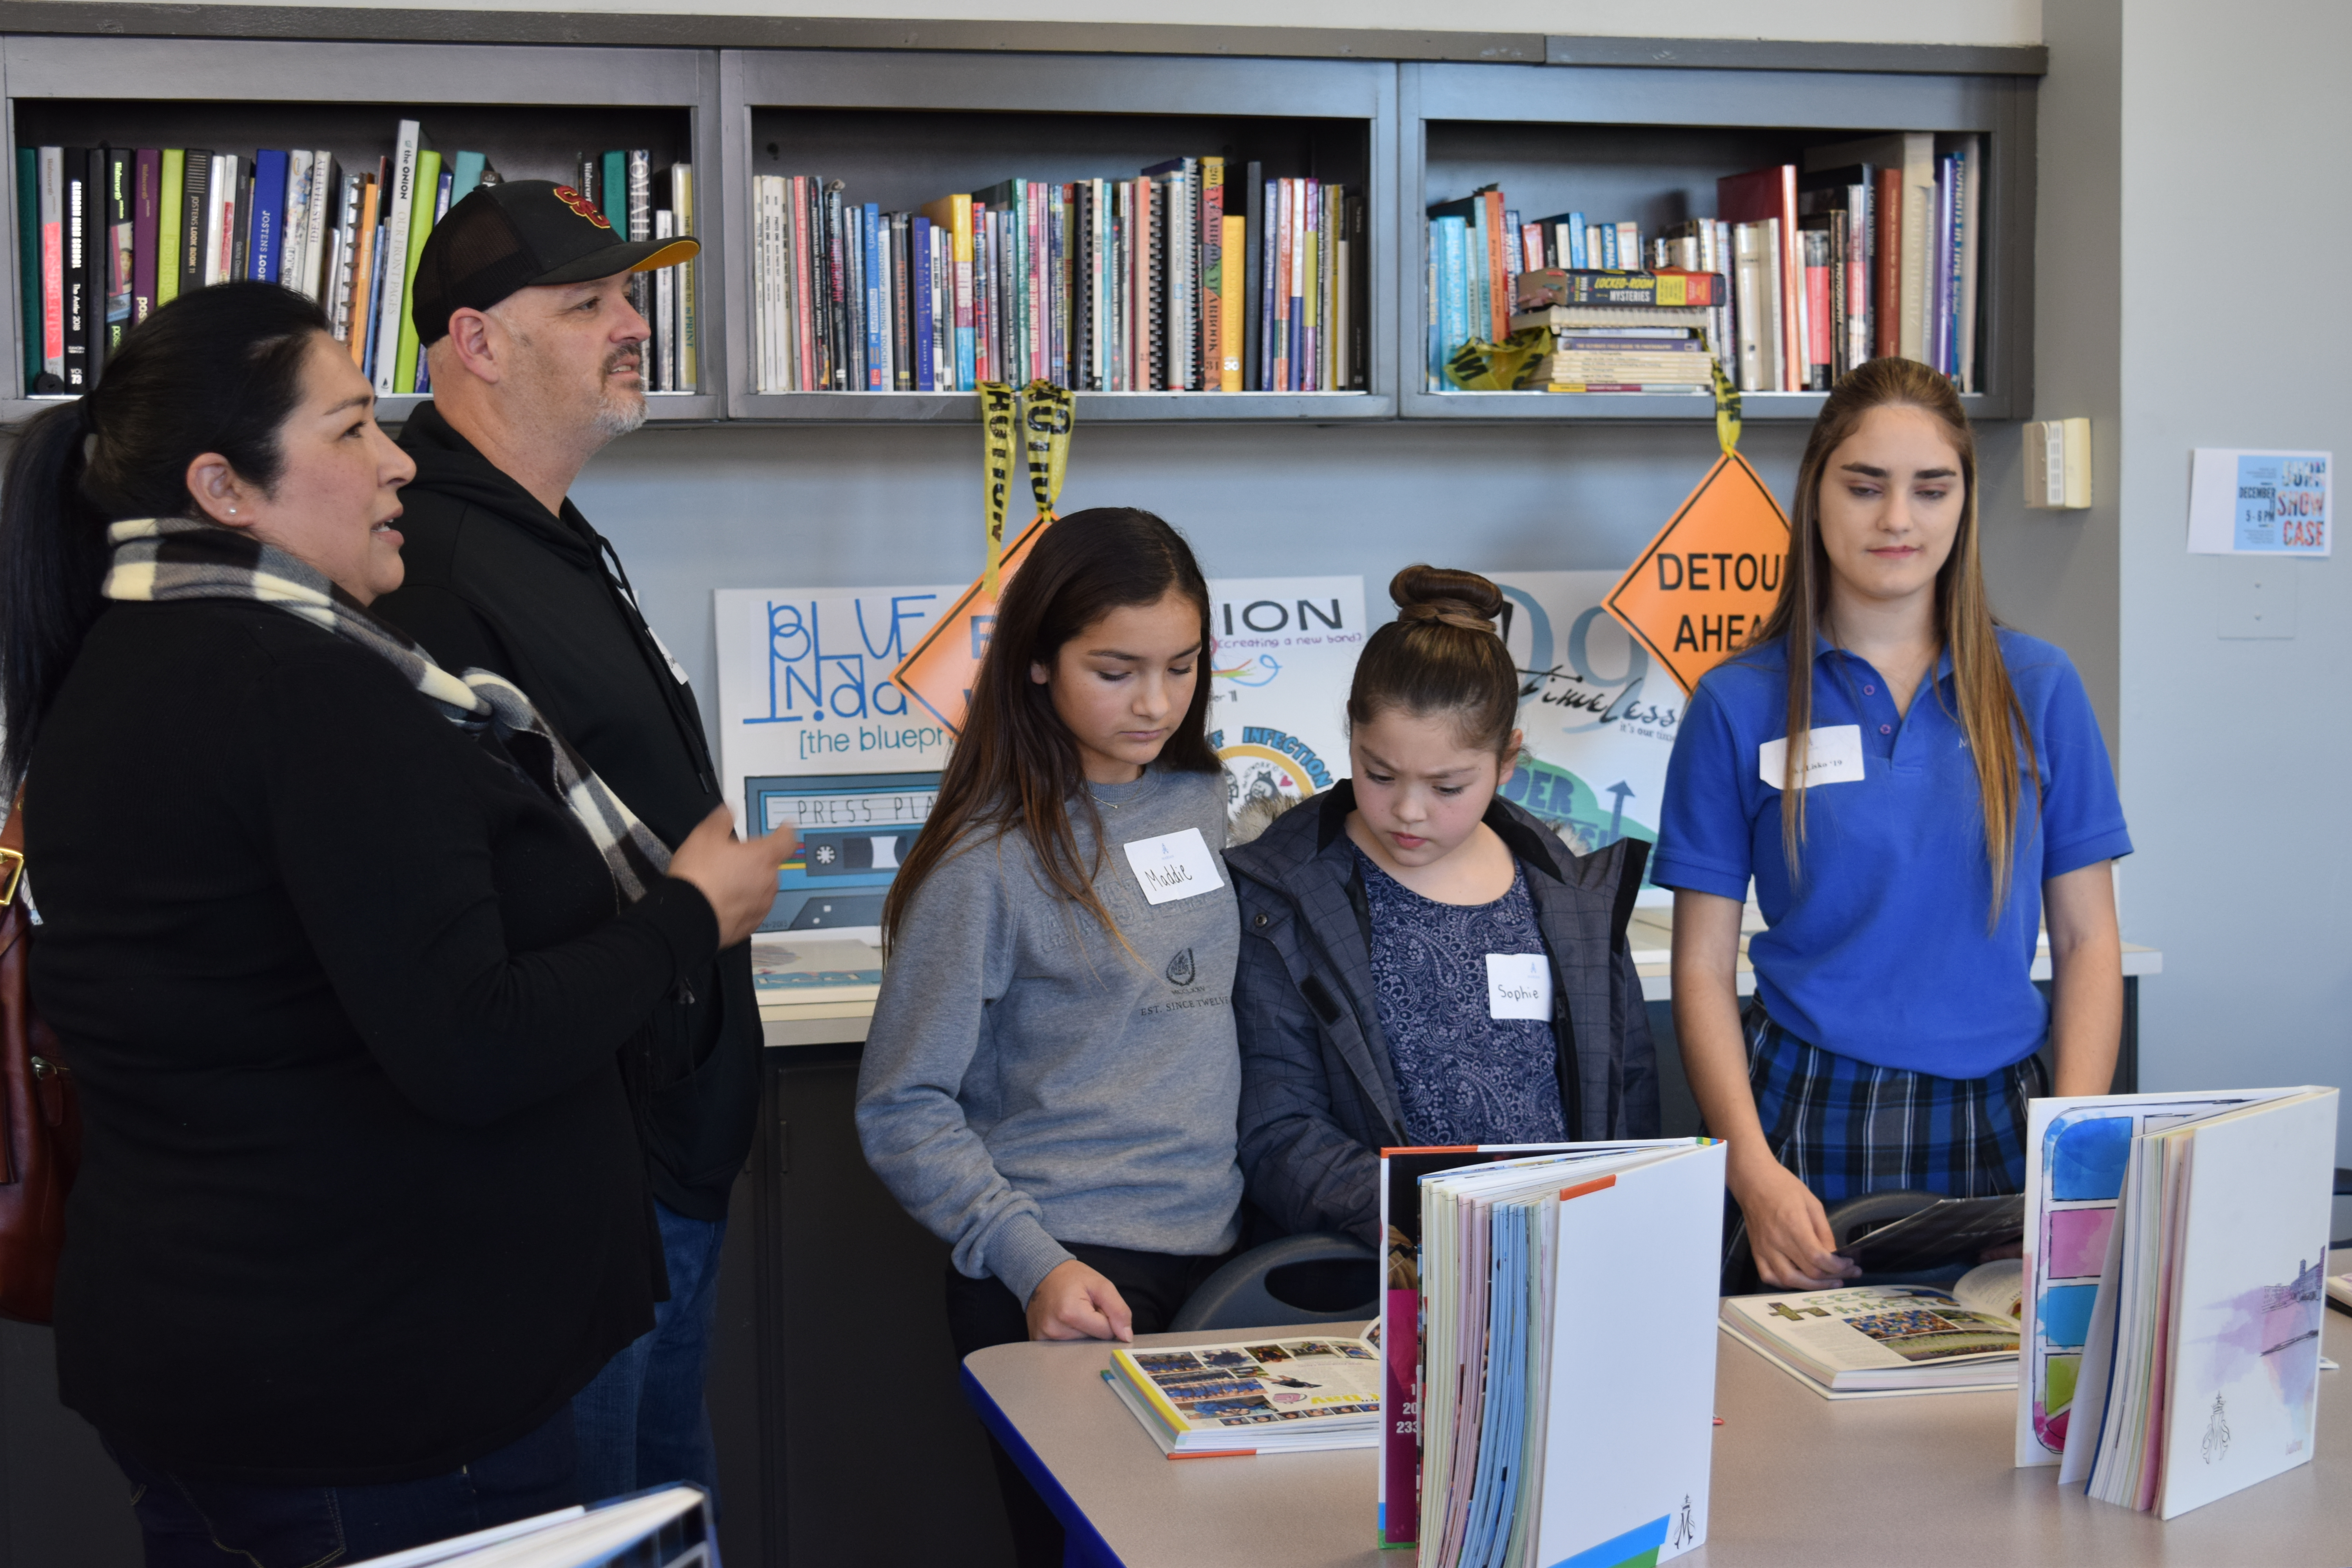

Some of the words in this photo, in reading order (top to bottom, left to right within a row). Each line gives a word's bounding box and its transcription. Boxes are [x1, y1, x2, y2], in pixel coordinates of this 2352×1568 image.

[317, 159, 326, 177] FLY
[403, 149, 411, 164] the
[114, 162, 123, 200] Walsworth
[313, 178, 322, 210] THAT
[400, 166, 410, 200] ONION
[1954, 161, 1964, 225] MOMENTS
[72, 181, 82, 216] ELKHORN
[191, 196, 200, 225] JOSTENS
[630, 161, 650, 241] OMAH
[72, 217, 82, 237] HIGH
[260, 210, 270, 252] JOSTENS
[310, 211, 320, 243] IDEAS
[396, 211, 407, 237] OUR
[867, 212, 876, 249] Langford's
[974, 207, 985, 230] The
[1175, 223, 1181, 233] ON
[1910, 191, 1922, 247] ALFRED
[1208, 196, 1219, 271] YEARBOOK
[1954, 227, 1963, 242] IN
[72, 238, 82, 268] SCHOOL
[392, 239, 405, 278] FRONT
[975, 232, 985, 276] Camera
[1229, 236, 1238, 291] YEARBOOK
[1506, 233, 1515, 272] MASS
[1953, 247, 1963, 276] TIME
[258, 254, 267, 281] LOOK
[830, 238, 844, 303] PHOTOGRAPHY
[897, 260, 906, 281] FIELD
[388, 281, 401, 314] PAGES
[685, 292, 691, 303] TO
[957, 262, 973, 308] EDITING
[976, 279, 986, 312] Never
[1029, 277, 1038, 291] FOR
[1429, 263, 1439, 325] Communication
[1508, 274, 1517, 318] MEDIA
[1594, 277, 1655, 289] LOCKED-ROOM
[1610, 290, 1650, 302] MYSTERIES
[1836, 261, 1844, 324] PHOTOGRAPHY
[1909, 250, 1921, 327] STIEGLITZ
[685, 306, 692, 314] IN
[1030, 292, 1039, 306] THE
[1208, 276, 1219, 351] YEARBOOK
[898, 282, 907, 346] PHOTOGRAPHY
[977, 314, 987, 338] Lies
[1030, 307, 1039, 328] PRINT
[1229, 297, 1238, 352] YEARBOOK
[685, 316, 695, 348] PRINT
[1030, 328, 1039, 352] MEDIA
[71, 374, 82, 384] 73
[1223, 361, 1240, 371] 30
[2239, 486, 2276, 499] DECEMBER
[2277, 490, 2325, 517] SHOW
[2263, 510, 2275, 522] PM
[2283, 520, 2324, 546] CASE
[1296, 635, 1321, 645] new
[800, 729, 850, 759] [the
[860, 725, 946, 753] bluepr
[1637, 728, 1653, 738] our
[1242, 726, 1334, 789] INFECTION
[797, 799, 872, 825] PRESS
[1144, 864, 1193, 891] Maddie
[1141, 1005, 1162, 1016] EST.
[1166, 1001, 1194, 1012] SINCE
[1196, 996, 1229, 1008] TWELVE
[1498, 984, 1539, 1002] Sophie
